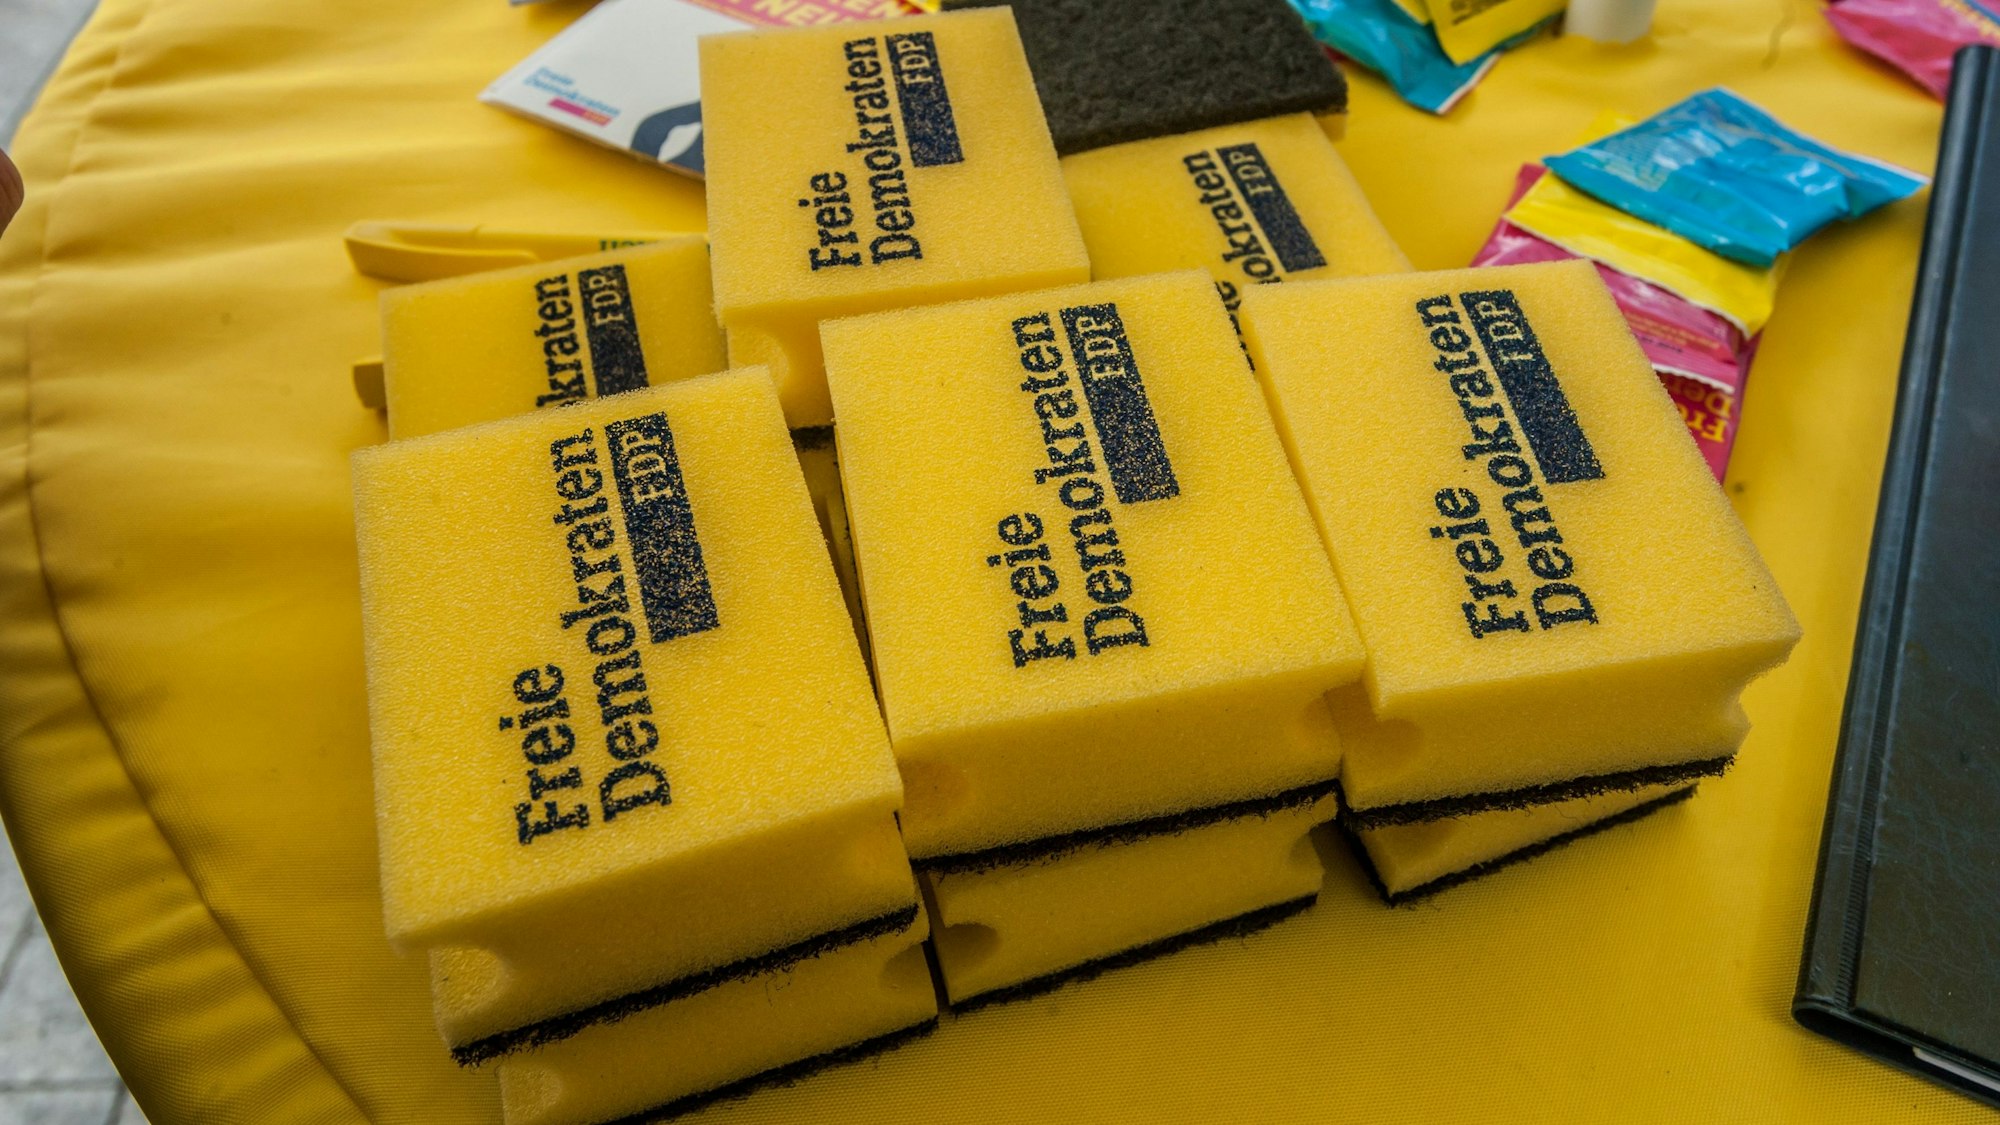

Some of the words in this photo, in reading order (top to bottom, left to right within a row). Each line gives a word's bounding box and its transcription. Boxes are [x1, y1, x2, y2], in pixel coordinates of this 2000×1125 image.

[896, 38, 934, 85] FDP
[843, 37, 923, 265] Demokraten
[1183, 150, 1283, 284] okraten
[1228, 151, 1275, 196] FDP
[798, 171, 862, 271] Freie
[534, 273, 589, 409] kraten
[588, 273, 625, 328] FDP
[1075, 314, 1126, 380] FDP
[1475, 299, 1535, 363] FDP
[617, 430, 675, 503] FDP
[1011, 311, 1151, 657] Demokraten
[1415, 294, 1600, 631] Demokraten
[550, 427, 673, 824] Demokraten
[986, 511, 1077, 669] Freie
[1429, 486, 1534, 640] Freie
[499, 662, 590, 845] Freie
